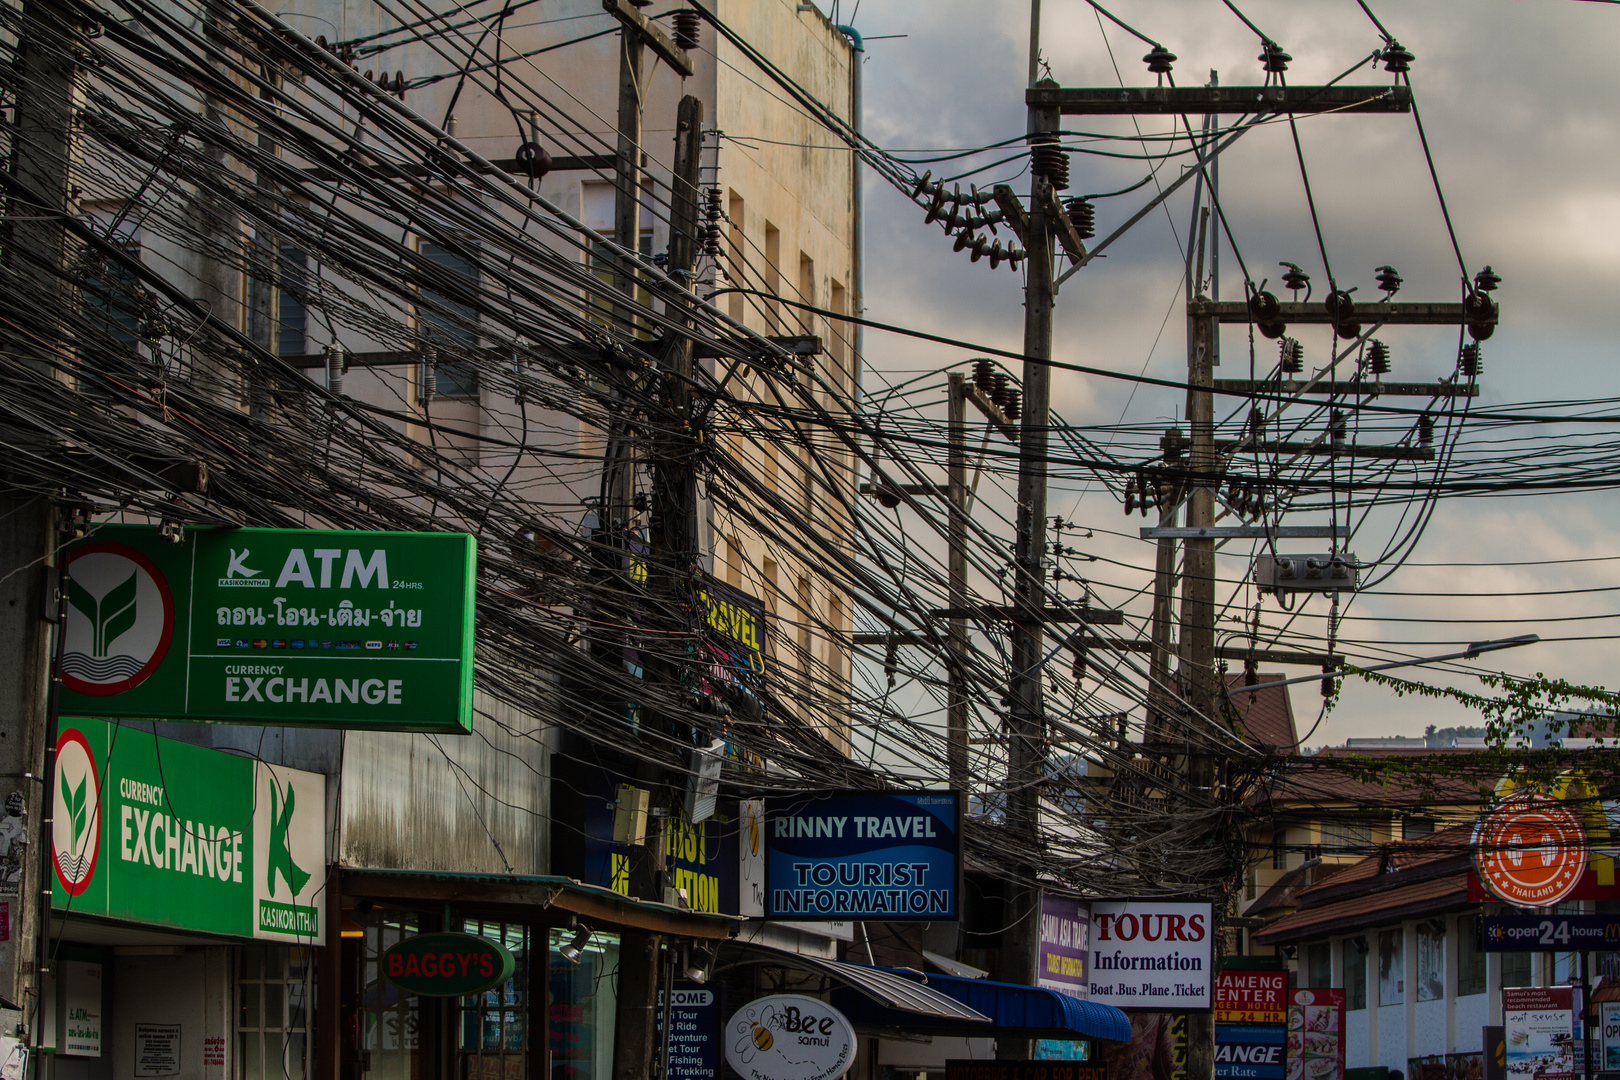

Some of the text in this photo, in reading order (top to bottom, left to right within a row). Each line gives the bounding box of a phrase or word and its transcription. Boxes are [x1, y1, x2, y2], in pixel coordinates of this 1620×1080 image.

[275, 548, 389, 589] ATM
[216, 597, 423, 628] ถอน-โอน-เติม-จ่าย
[699, 590, 760, 650] RAVEL
[225, 665, 284, 675] CURRENCY
[225, 677, 402, 705] EXCHANGE
[120, 777, 164, 807] CURRENCY
[774, 816, 937, 838] RINNY TRAVEL
[121, 804, 243, 884] EXCHANGE
[793, 863, 930, 886] TOURIST
[773, 889, 949, 914] INFORMATION
[1511, 885, 1555, 898] THAILAND
[260, 906, 317, 933] KASIKORNTHAI
[1094, 913, 1205, 942] TOURS
[1041, 913, 1089, 952] SAMUI ASIA TRAVEL
[1507, 920, 1604, 945] open 24 hours
[388, 952, 495, 977] BAGGY'S
[1046, 952, 1083, 978] TOURIST INFORMATION
[1094, 950, 1202, 971] Information
[1090, 983, 1113, 996] Boat
[1215, 976, 1283, 989] HAWENG
[1217, 989, 1276, 1002] ENTER
[1247, 1002, 1282, 1010] HOTEL
[676, 1022, 697, 1031] Ride
[677, 1011, 698, 1020] Tour
[785, 1006, 835, 1036] Bee
[1240, 1012, 1255, 1021] 24
[1263, 1013, 1283, 1022] HR.
[669, 1033, 708, 1042] dventure
[798, 1036, 830, 1047] samui
[680, 1045, 700, 1053] Tour
[827, 1058, 845, 1075] Honey
[839, 1043, 848, 1058] Bees
[670, 1056, 703, 1066] Fishing
[675, 1067, 714, 1077] Trekking
[1231, 1066, 1257, 1077] Rate
